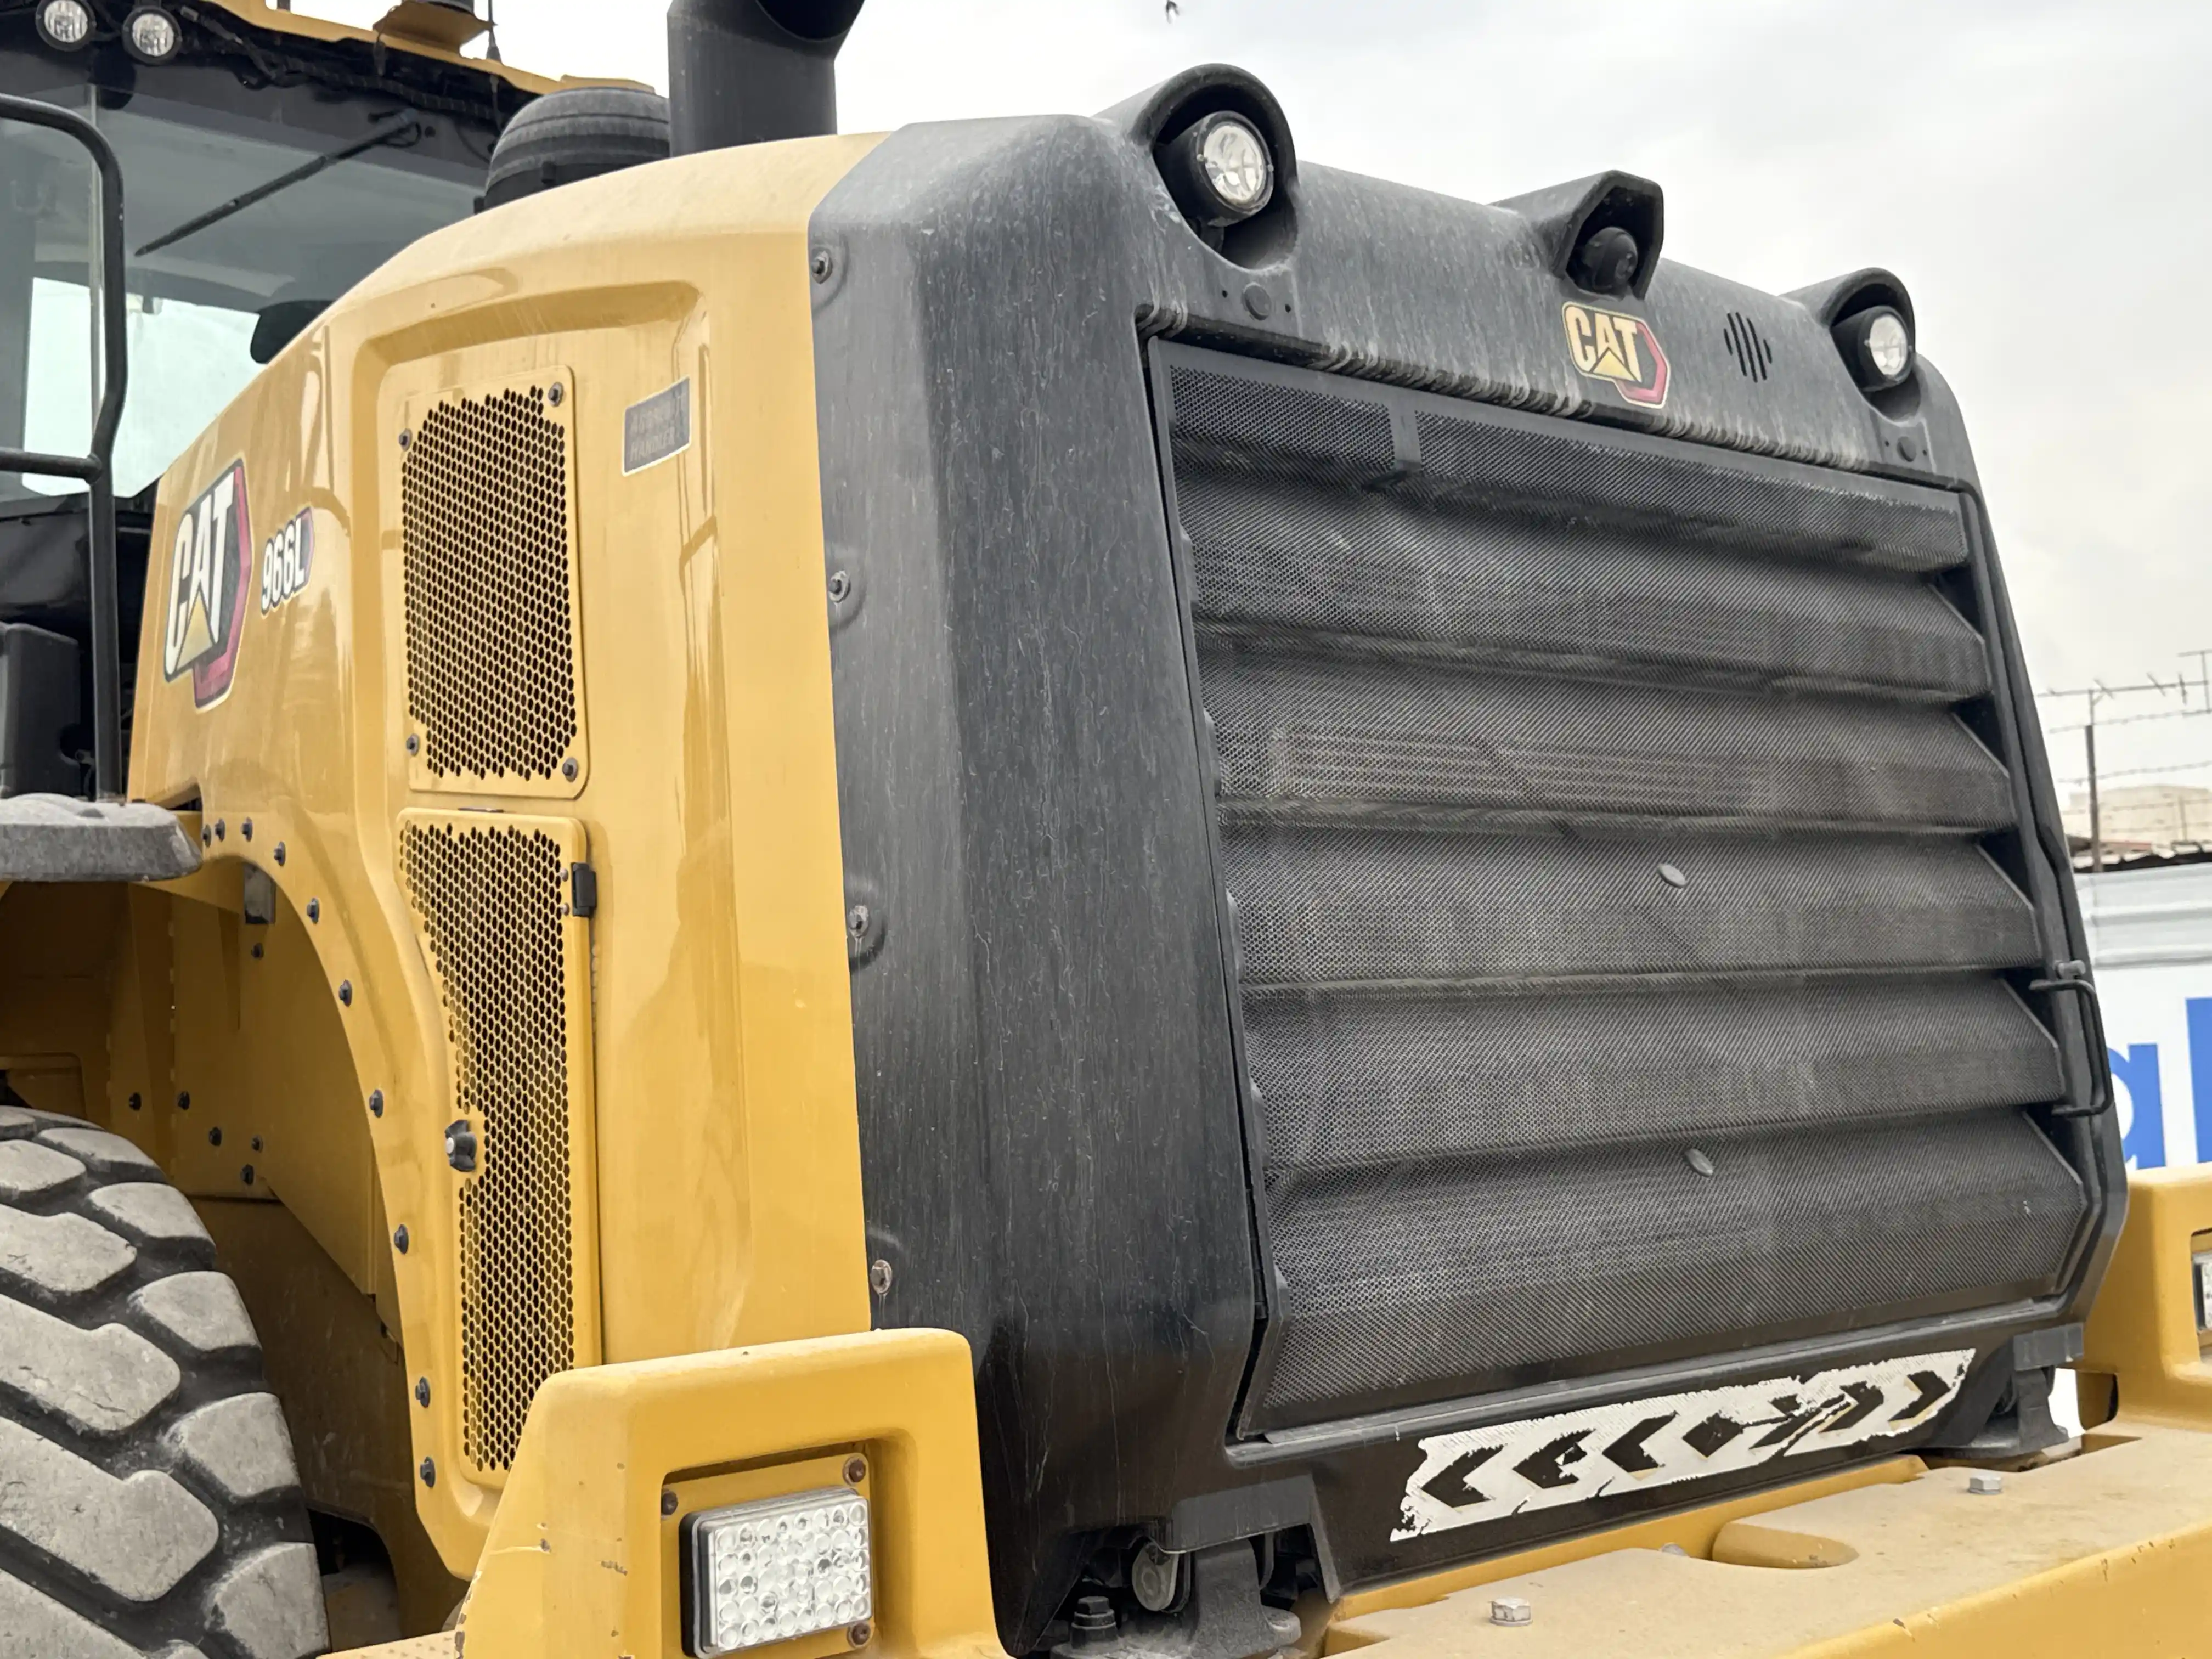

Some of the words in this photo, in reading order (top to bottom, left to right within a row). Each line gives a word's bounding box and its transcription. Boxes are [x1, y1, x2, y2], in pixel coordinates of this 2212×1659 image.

[1565, 306, 1642, 383] CAT
[167, 472, 235, 675] CAT
[262, 519, 305, 610] 966L
